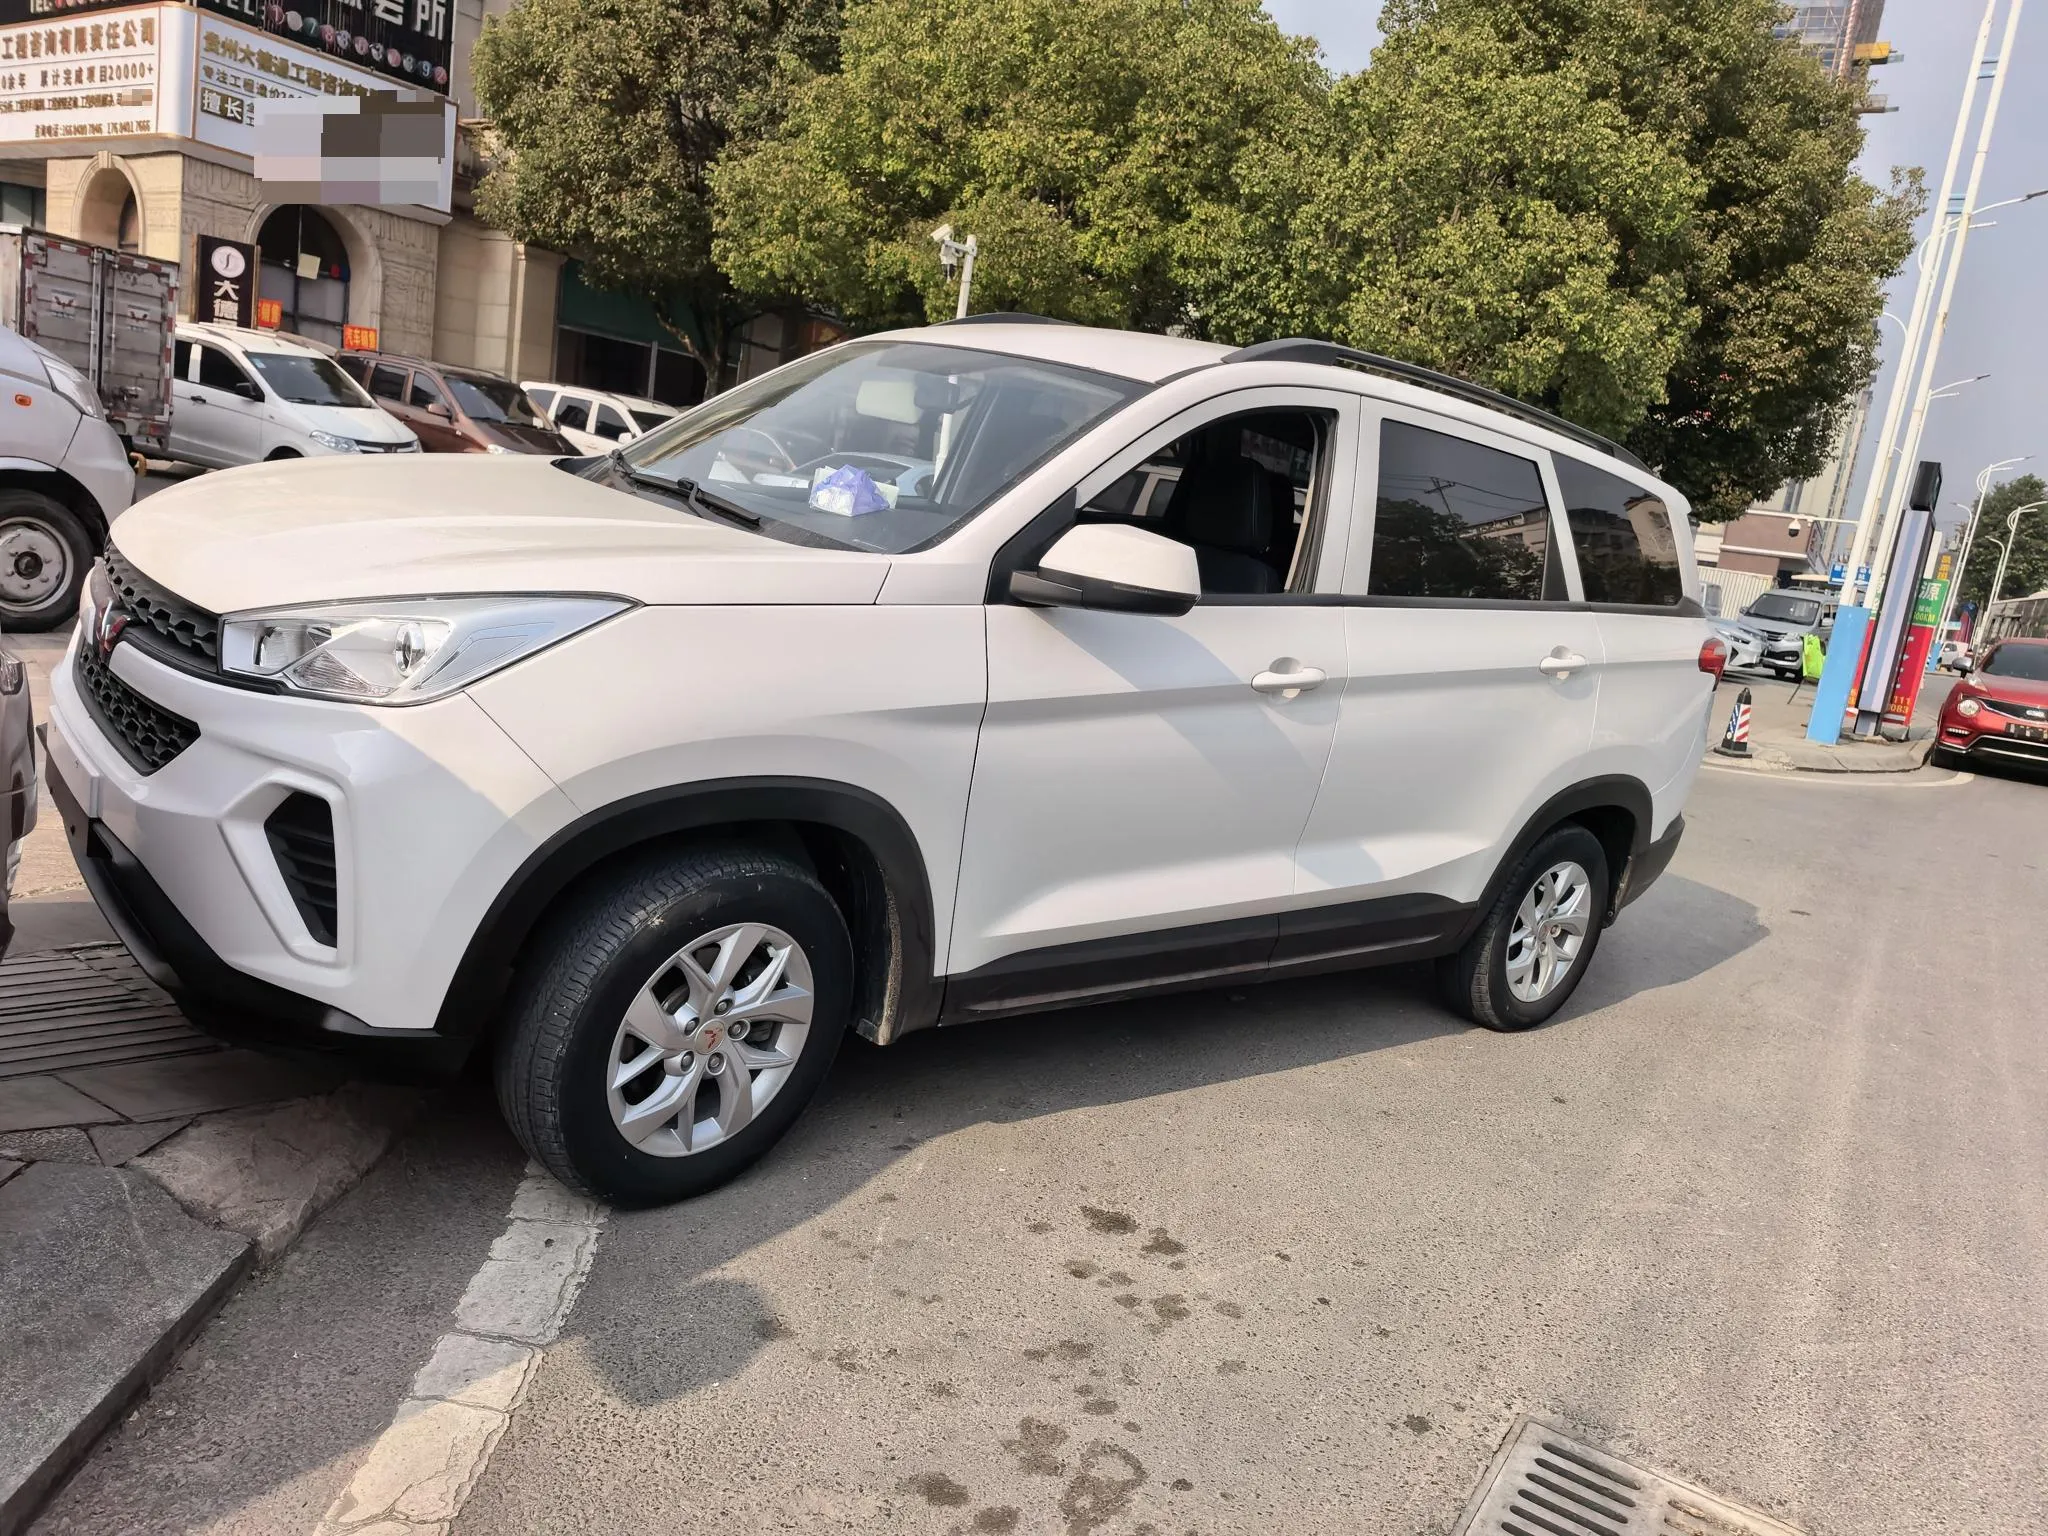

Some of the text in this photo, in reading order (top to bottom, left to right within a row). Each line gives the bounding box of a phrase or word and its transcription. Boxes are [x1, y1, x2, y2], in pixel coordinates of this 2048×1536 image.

[2, 17, 155, 60] 工程咨询有限责任公司
[203, 90, 242, 120] 擅长
